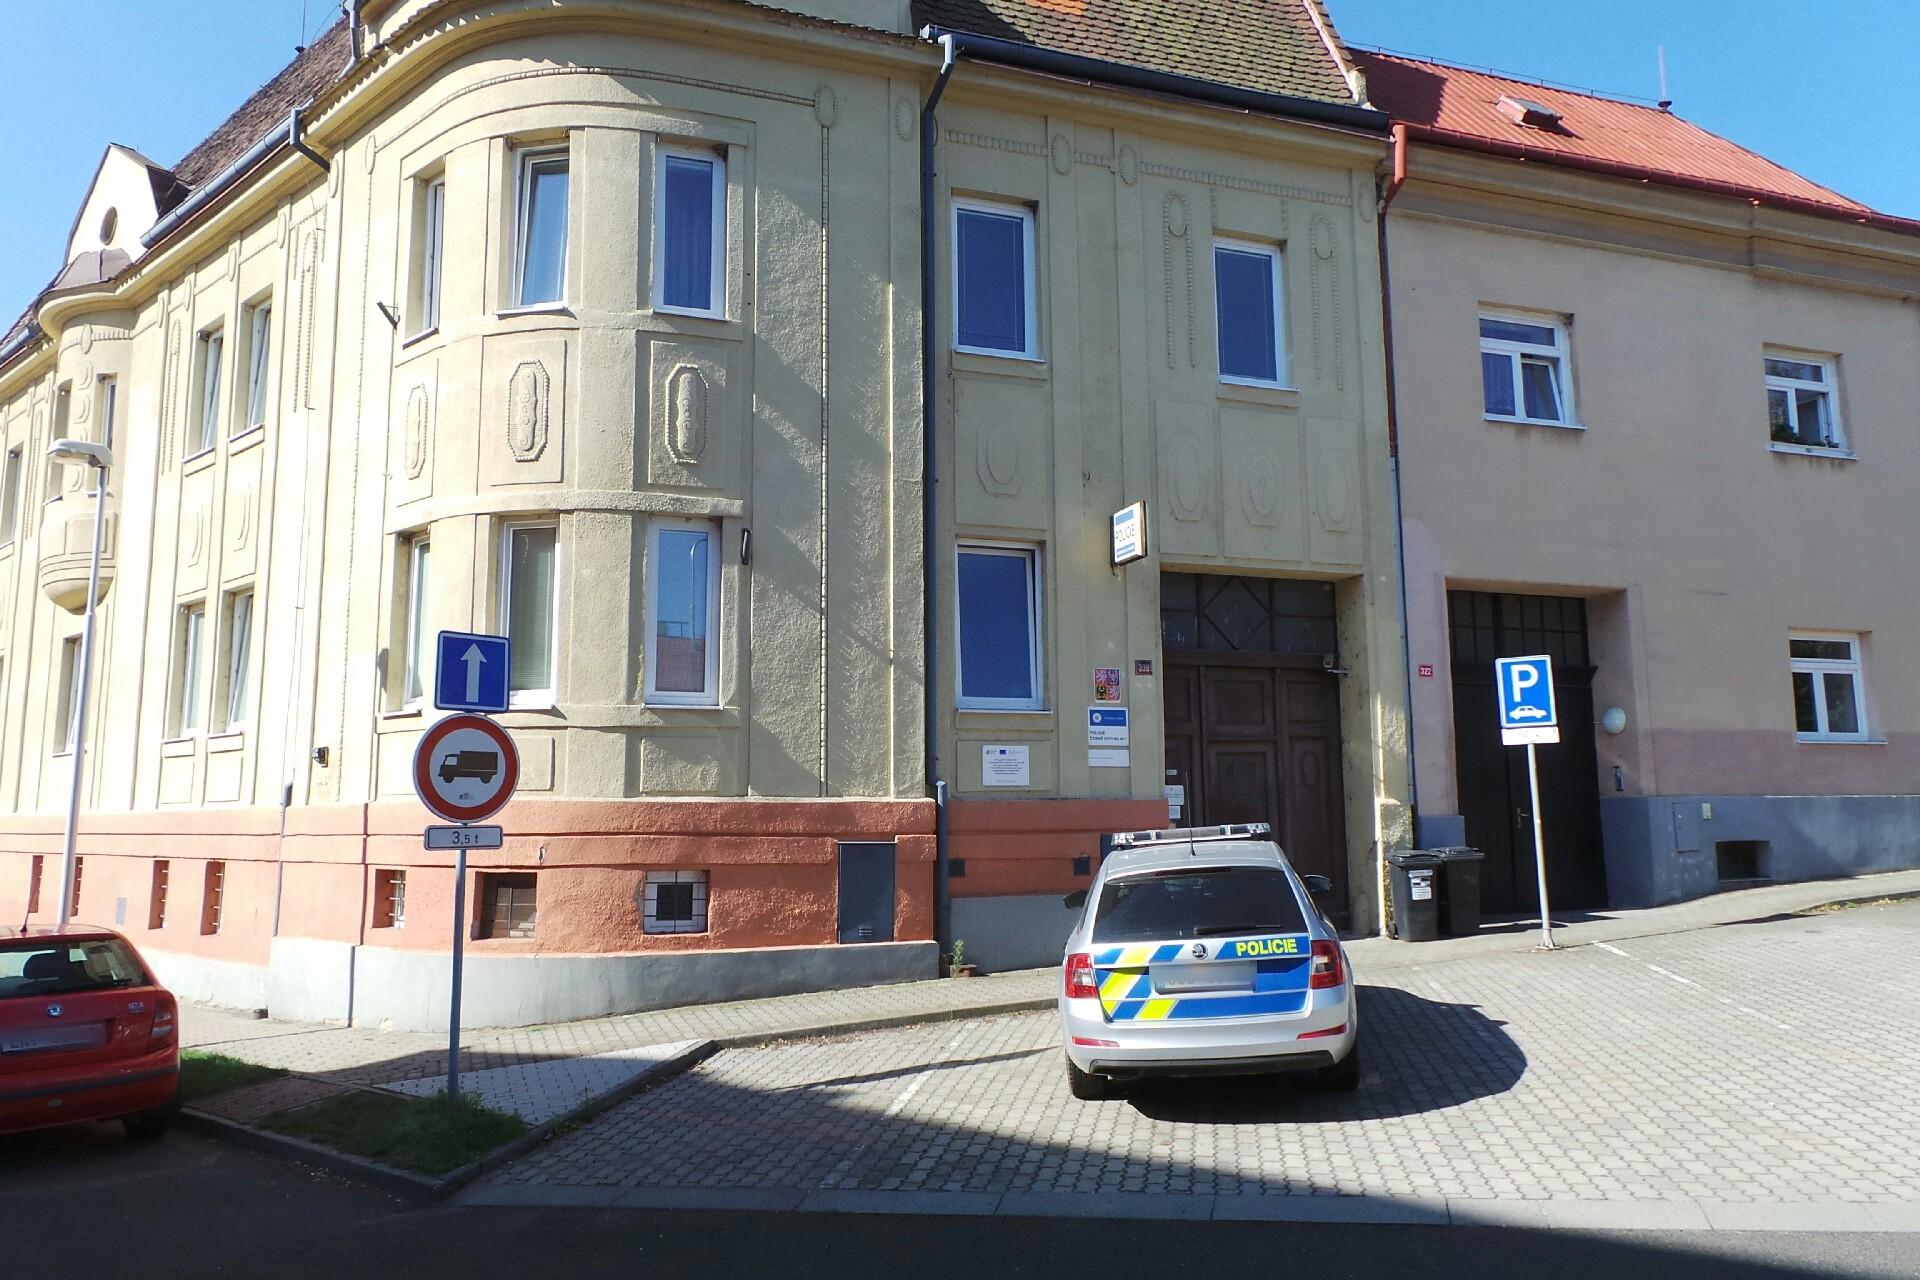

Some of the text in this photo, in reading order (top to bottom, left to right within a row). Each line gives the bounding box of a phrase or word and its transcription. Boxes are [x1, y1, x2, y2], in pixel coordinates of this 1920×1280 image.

[1420, 667, 1431, 675] 322
[1510, 664, 1539, 702] P
[474, 834, 479, 844] t
[1236, 938, 1298, 957] POLICIE
